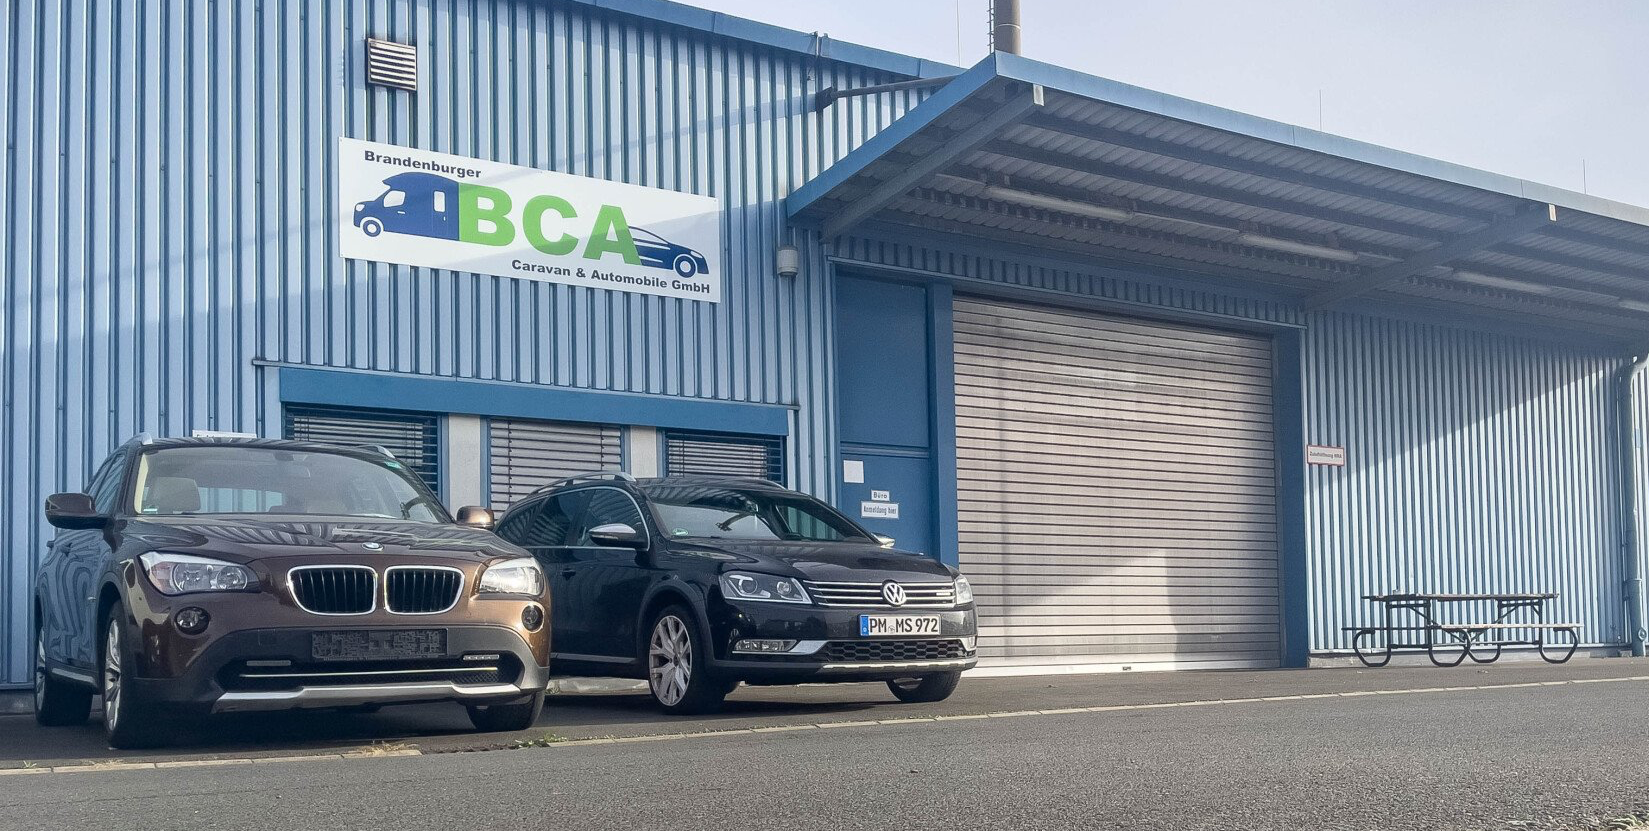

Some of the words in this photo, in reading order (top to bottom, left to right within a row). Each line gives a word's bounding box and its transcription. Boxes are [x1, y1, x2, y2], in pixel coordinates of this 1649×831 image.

[364, 150, 482, 179] Brandenburger
[458, 182, 642, 266] BCA
[511, 260, 571, 277] Caravan
[576, 267, 586, 278] &
[591, 269, 668, 289] Automobile
[671, 280, 711, 294] GmbH
[873, 491, 888, 499] Büro
[863, 505, 887, 516] Anmeldung
[888, 506, 897, 515] hier
[869, 618, 887, 633] PM
[895, 618, 913, 633] MS
[915, 618, 938, 633] 972
